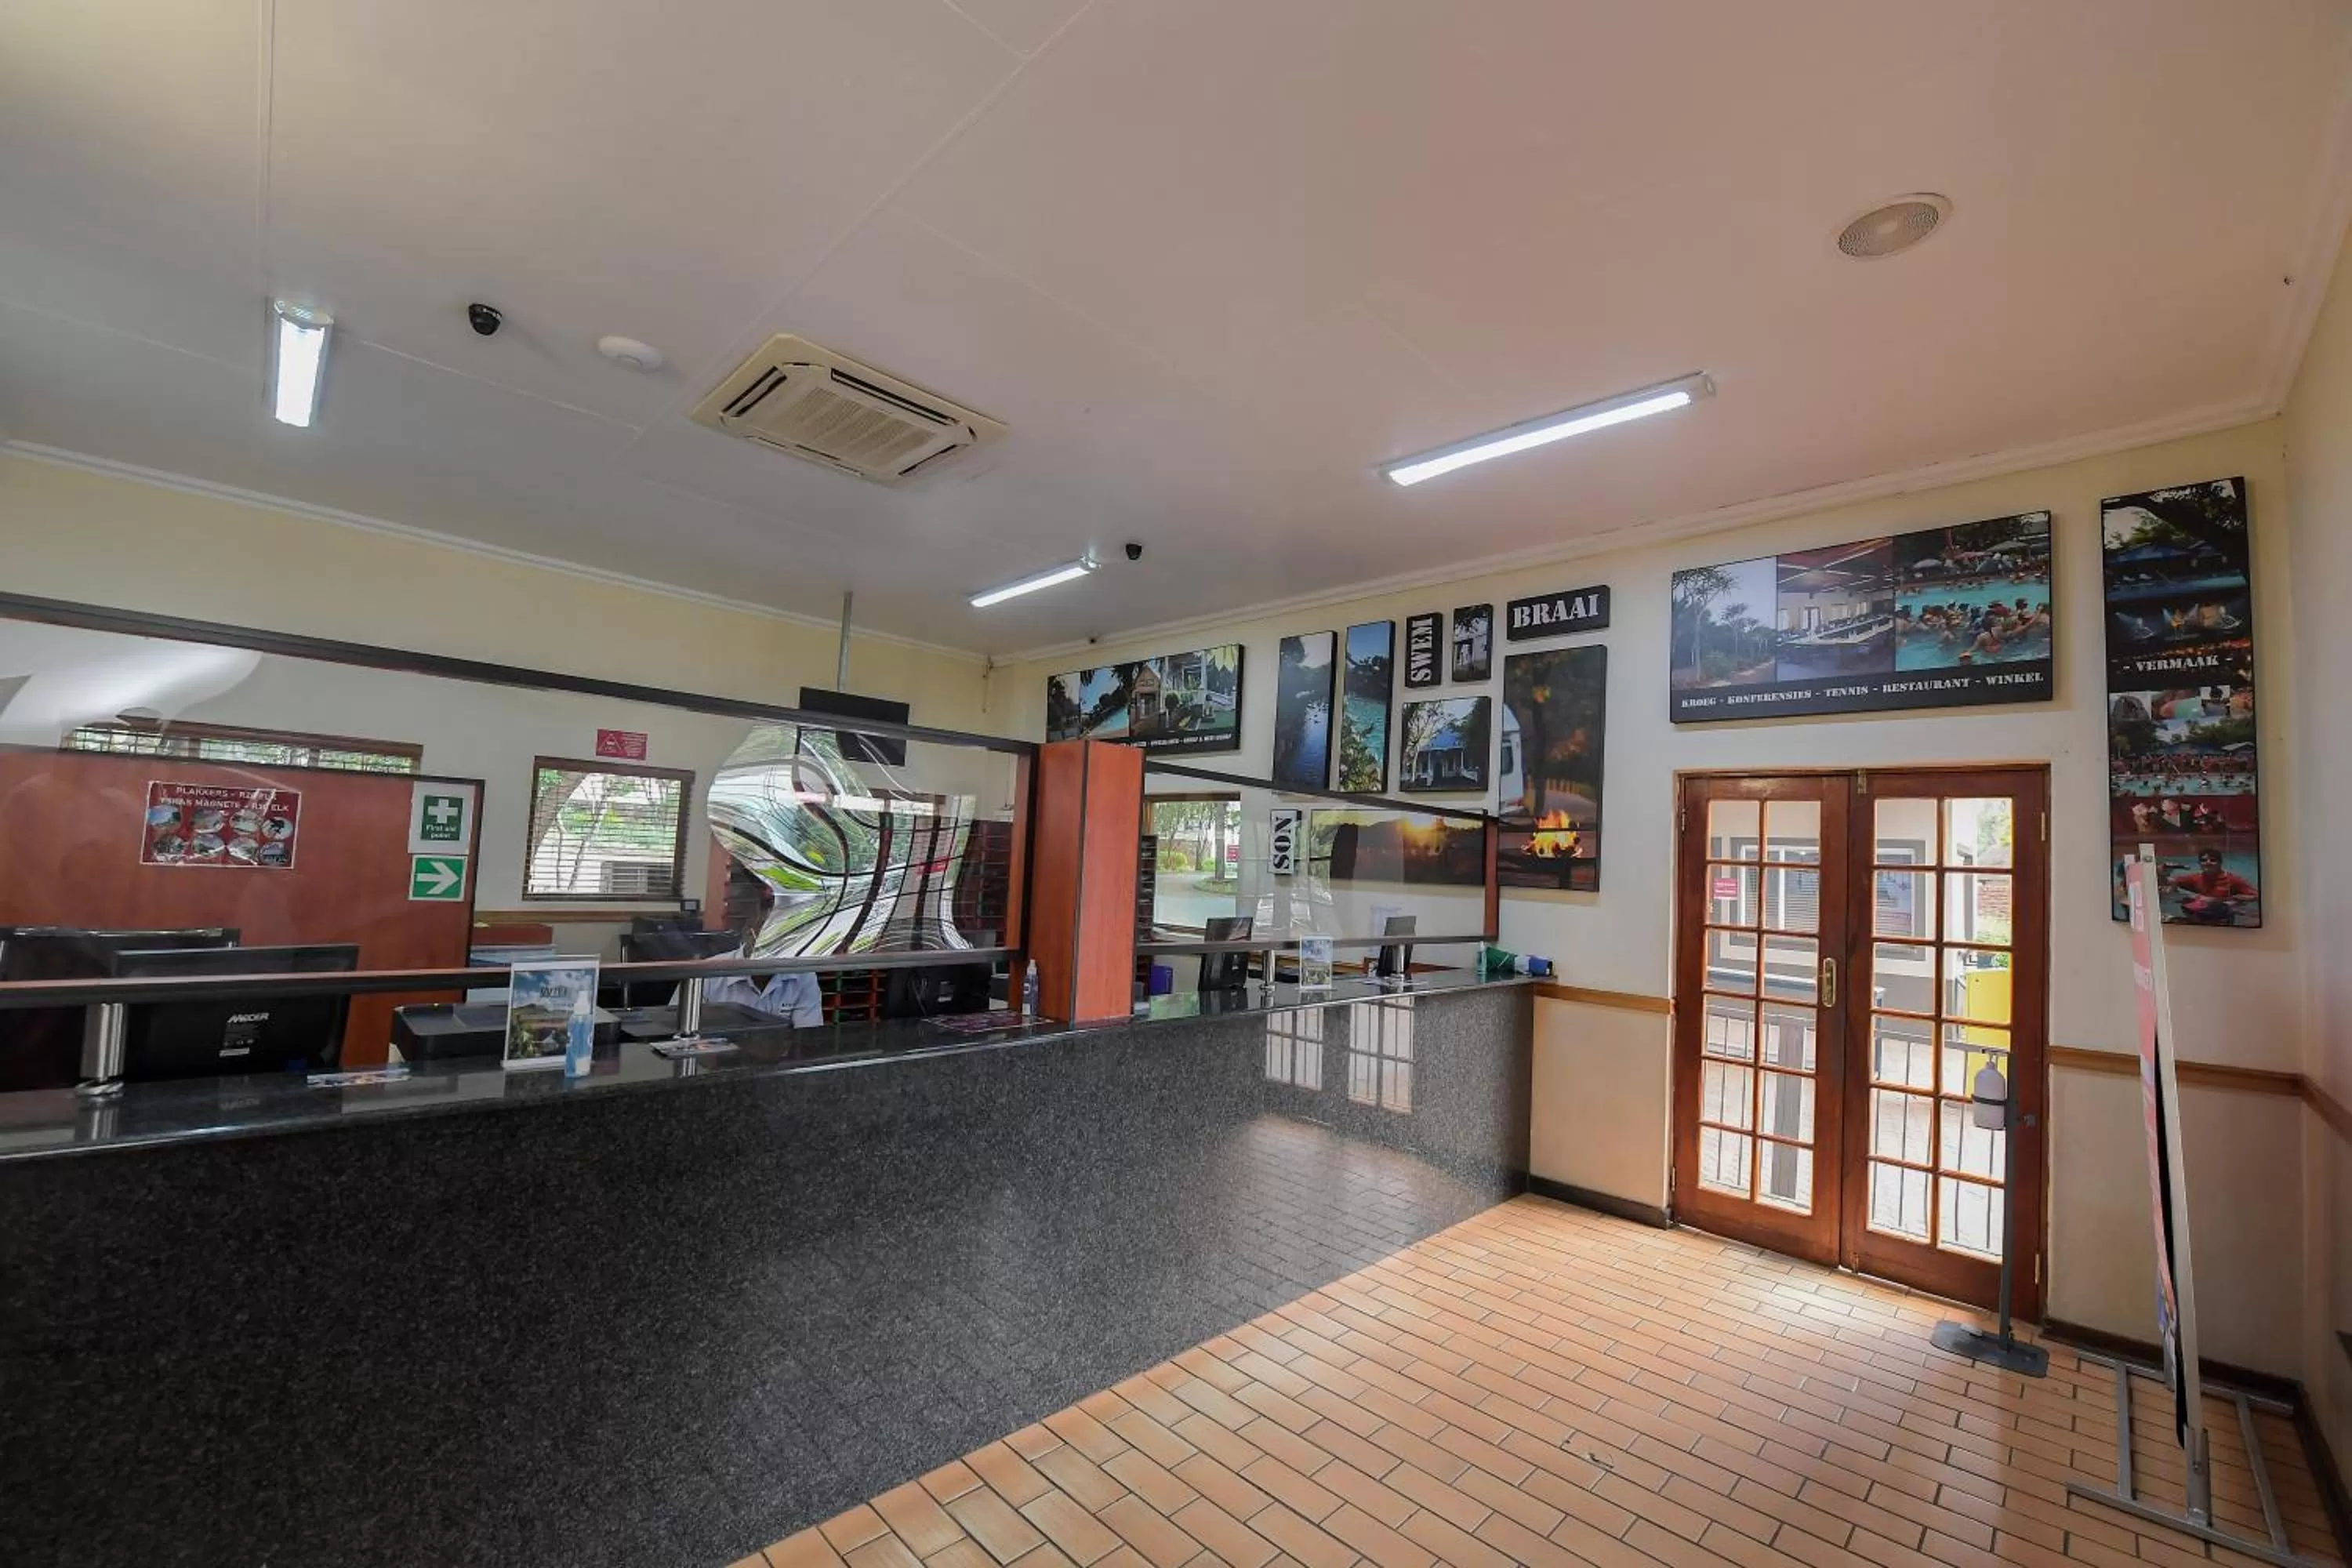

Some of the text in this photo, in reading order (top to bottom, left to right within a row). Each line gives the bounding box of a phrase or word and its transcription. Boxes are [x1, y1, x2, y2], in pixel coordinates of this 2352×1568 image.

[1513, 593, 1599, 627] BRAAI
[1411, 617, 1433, 681] SWEM
[2136, 655, 2220, 672] VERMAAK
[1727, 690, 1812, 705] KONFERENSIES
[1823, 686, 1869, 697] TENNIS
[1882, 677, 1970, 693] RESTAURANT
[1986, 672, 2044, 685] WINKEL
[1273, 817, 1291, 869] SON
